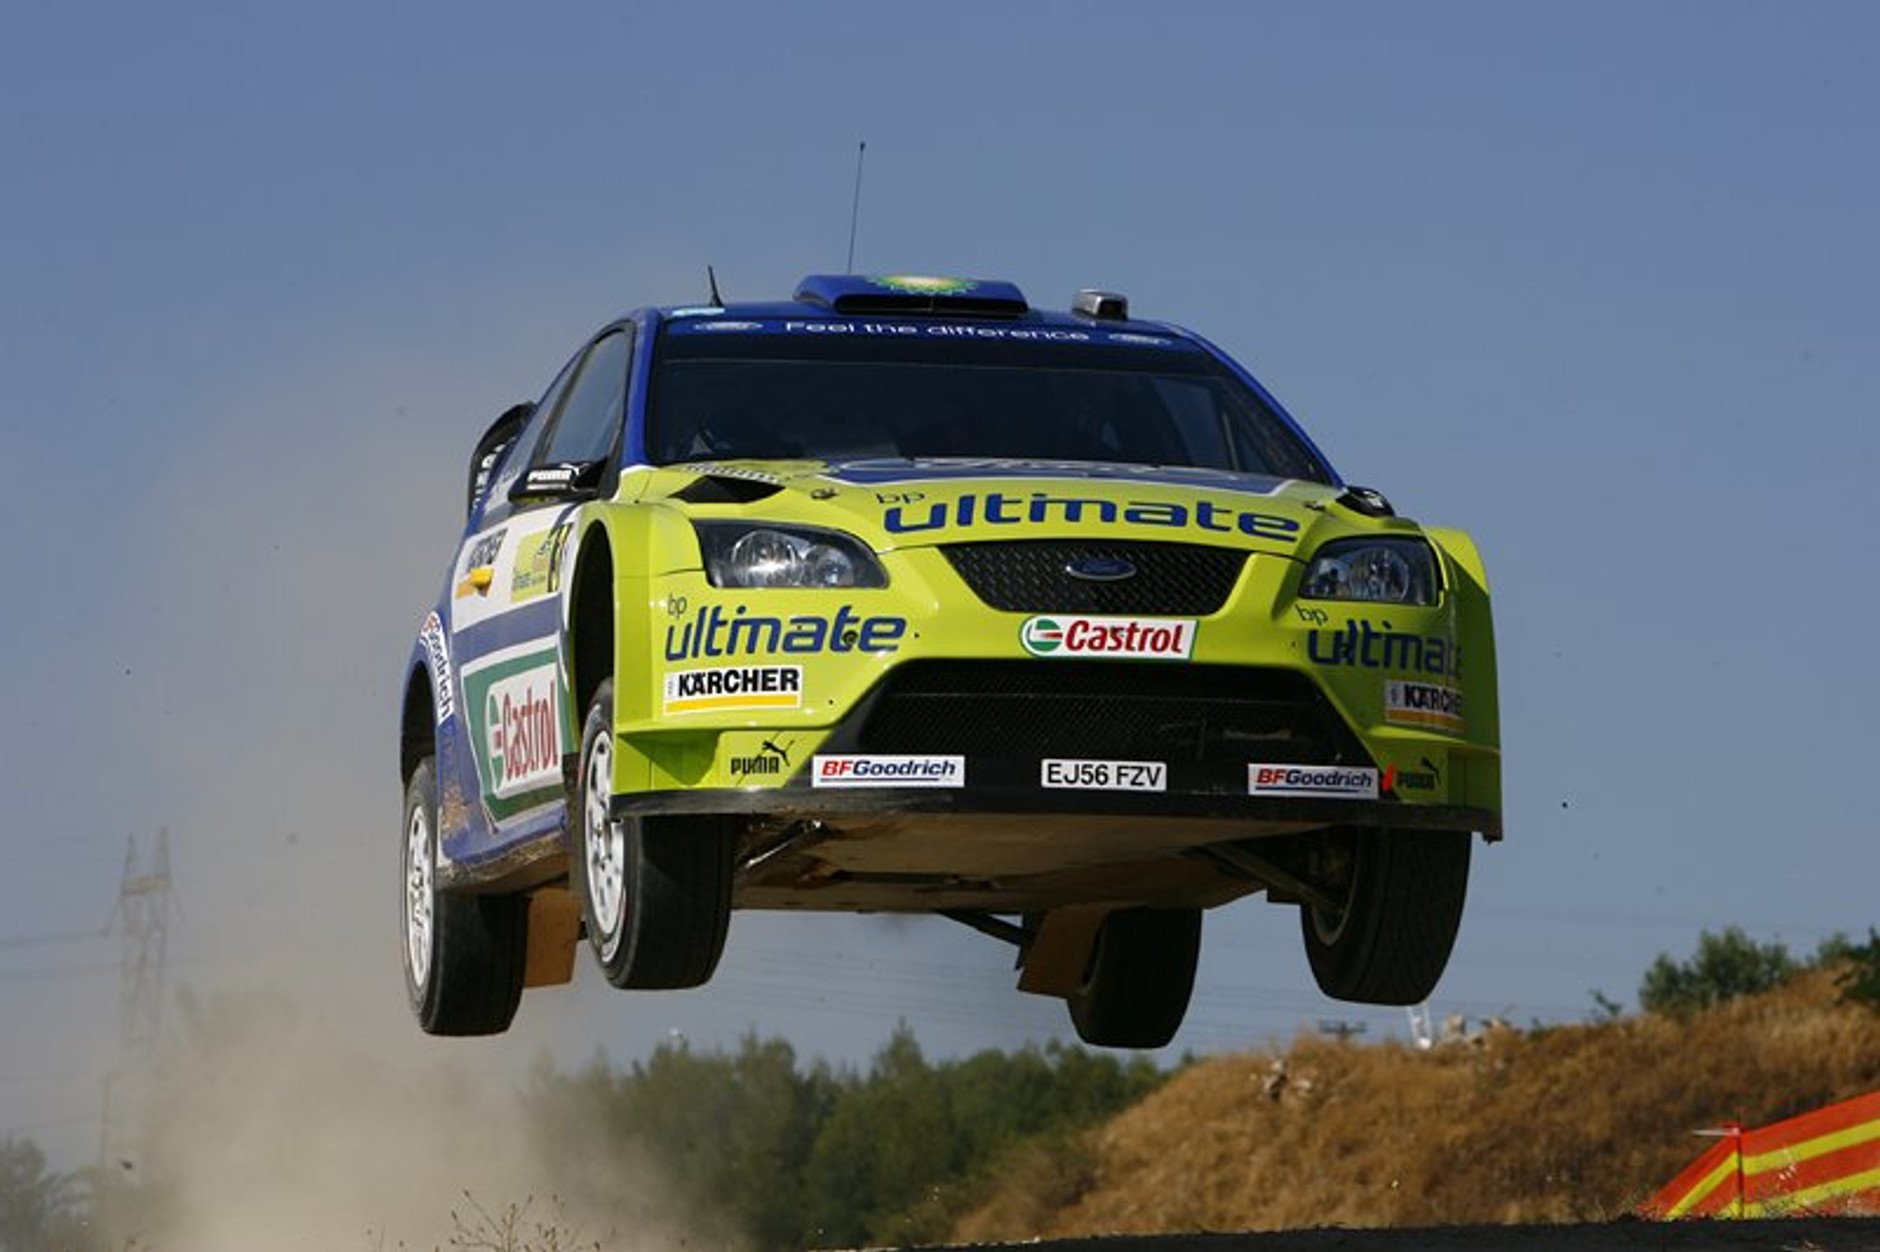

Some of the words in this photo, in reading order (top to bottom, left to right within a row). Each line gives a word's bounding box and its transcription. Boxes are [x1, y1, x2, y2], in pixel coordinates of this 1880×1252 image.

[786, 320, 855, 333] Feel
[863, 321, 918, 334] the
[927, 325, 1090, 341] difference
[875, 491, 926, 505] bp
[883, 492, 1301, 542] ultimate
[667, 594, 688, 619] bp
[1295, 604, 1329, 626] bp
[664, 605, 907, 662] ultimate
[1065, 620, 1183, 654] Castrol
[1307, 619, 1463, 679] ultima
[678, 667, 800, 698] KÄRCHER
[502, 679, 560, 781] Castrol
[730, 756, 780, 776] PUMA
[821, 758, 956, 777] BFGoodrich
[1047, 762, 1109, 786] EJ56
[1115, 764, 1162, 787] FZV
[1257, 768, 1372, 788] BFGoodrich
